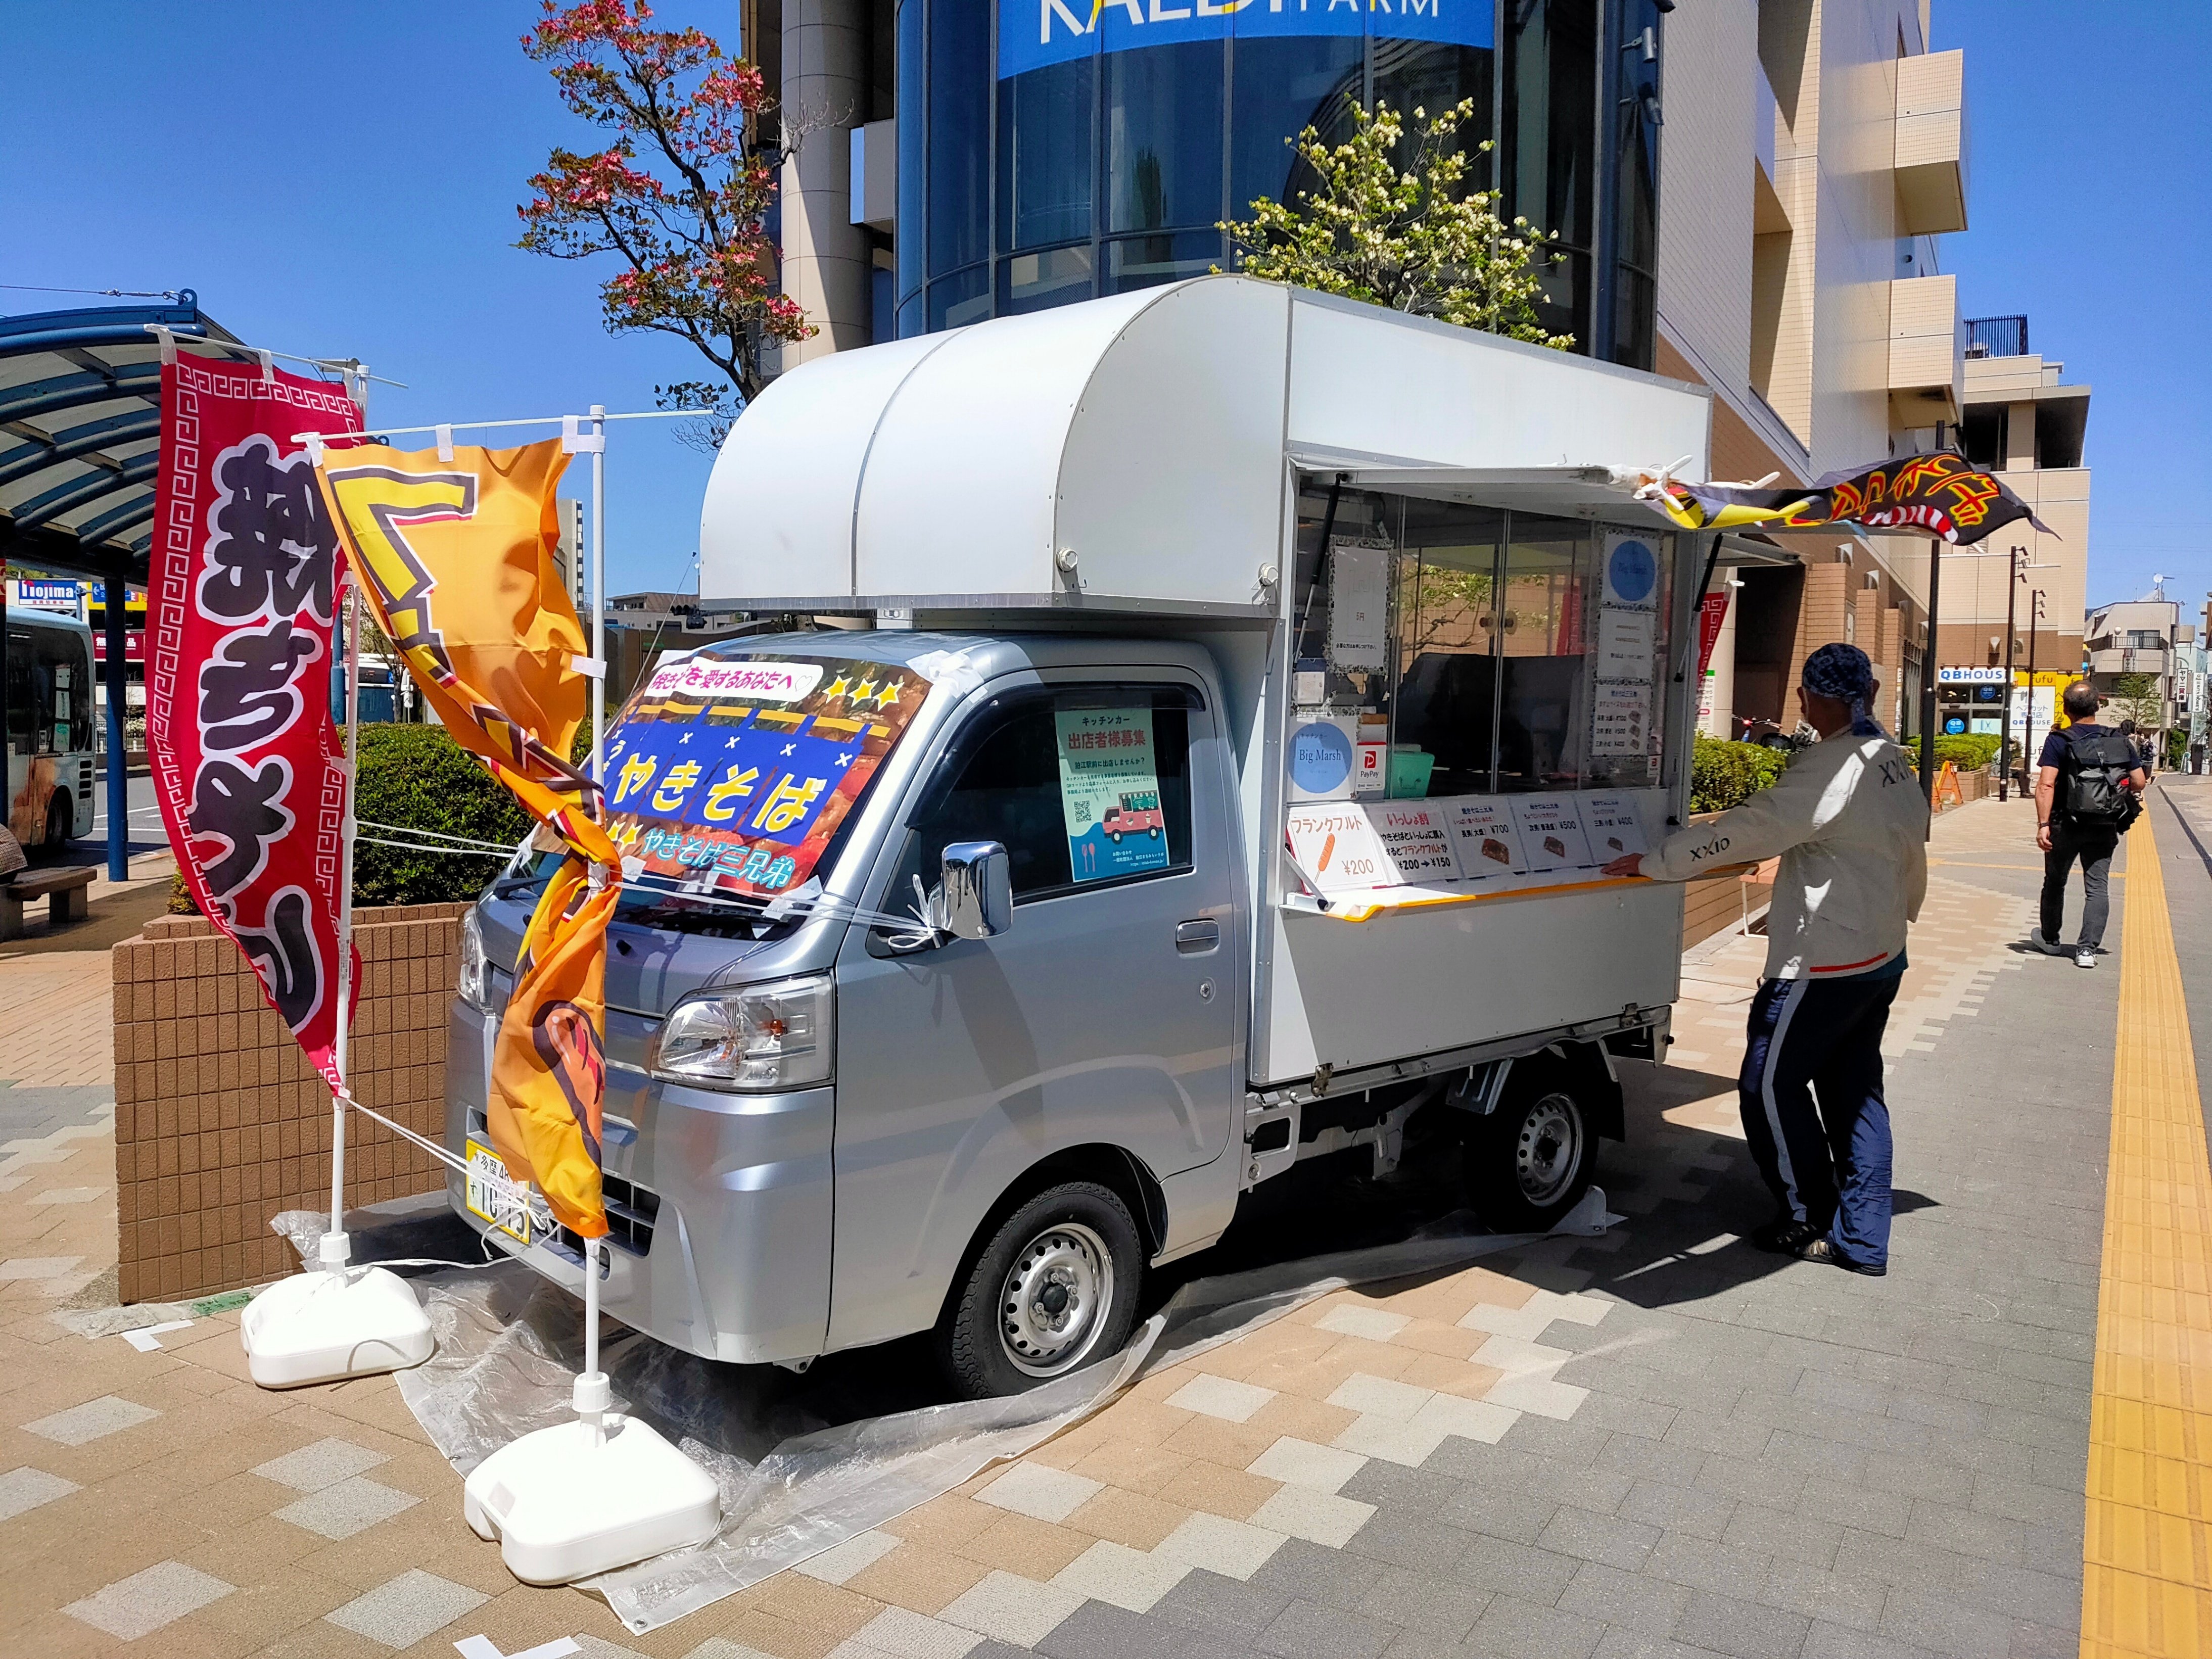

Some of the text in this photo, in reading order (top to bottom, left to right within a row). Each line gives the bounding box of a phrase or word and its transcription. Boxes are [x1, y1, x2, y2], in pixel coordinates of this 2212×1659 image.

[1941, 670, 2004, 681] QBHOUS
[1081, 715, 1130, 727] キッチンカー
[1068, 729, 1146, 749] 出店者様募集
[1299, 749, 1341, 764] Big Marsh
[613, 751, 827, 834] やきそば
[1292, 815, 1362, 834] フランクフルト
[1386, 812, 1429, 826] いっしょ割
[1559, 820, 1577, 829] ¥500
[1618, 817, 1633, 825] ¥400
[1490, 824, 1509, 834] ¥700
[1380, 830, 1445, 842] やきそばといっしょに購入
[1386, 843, 1448, 856] するとフランクフルトが
[1689, 834, 1730, 861] XXIO
[1342, 859, 1374, 875] ¥200
[1397, 857, 1450, 870] ¥200 ¥150
[481, 1155, 497, 1176] 多摩
